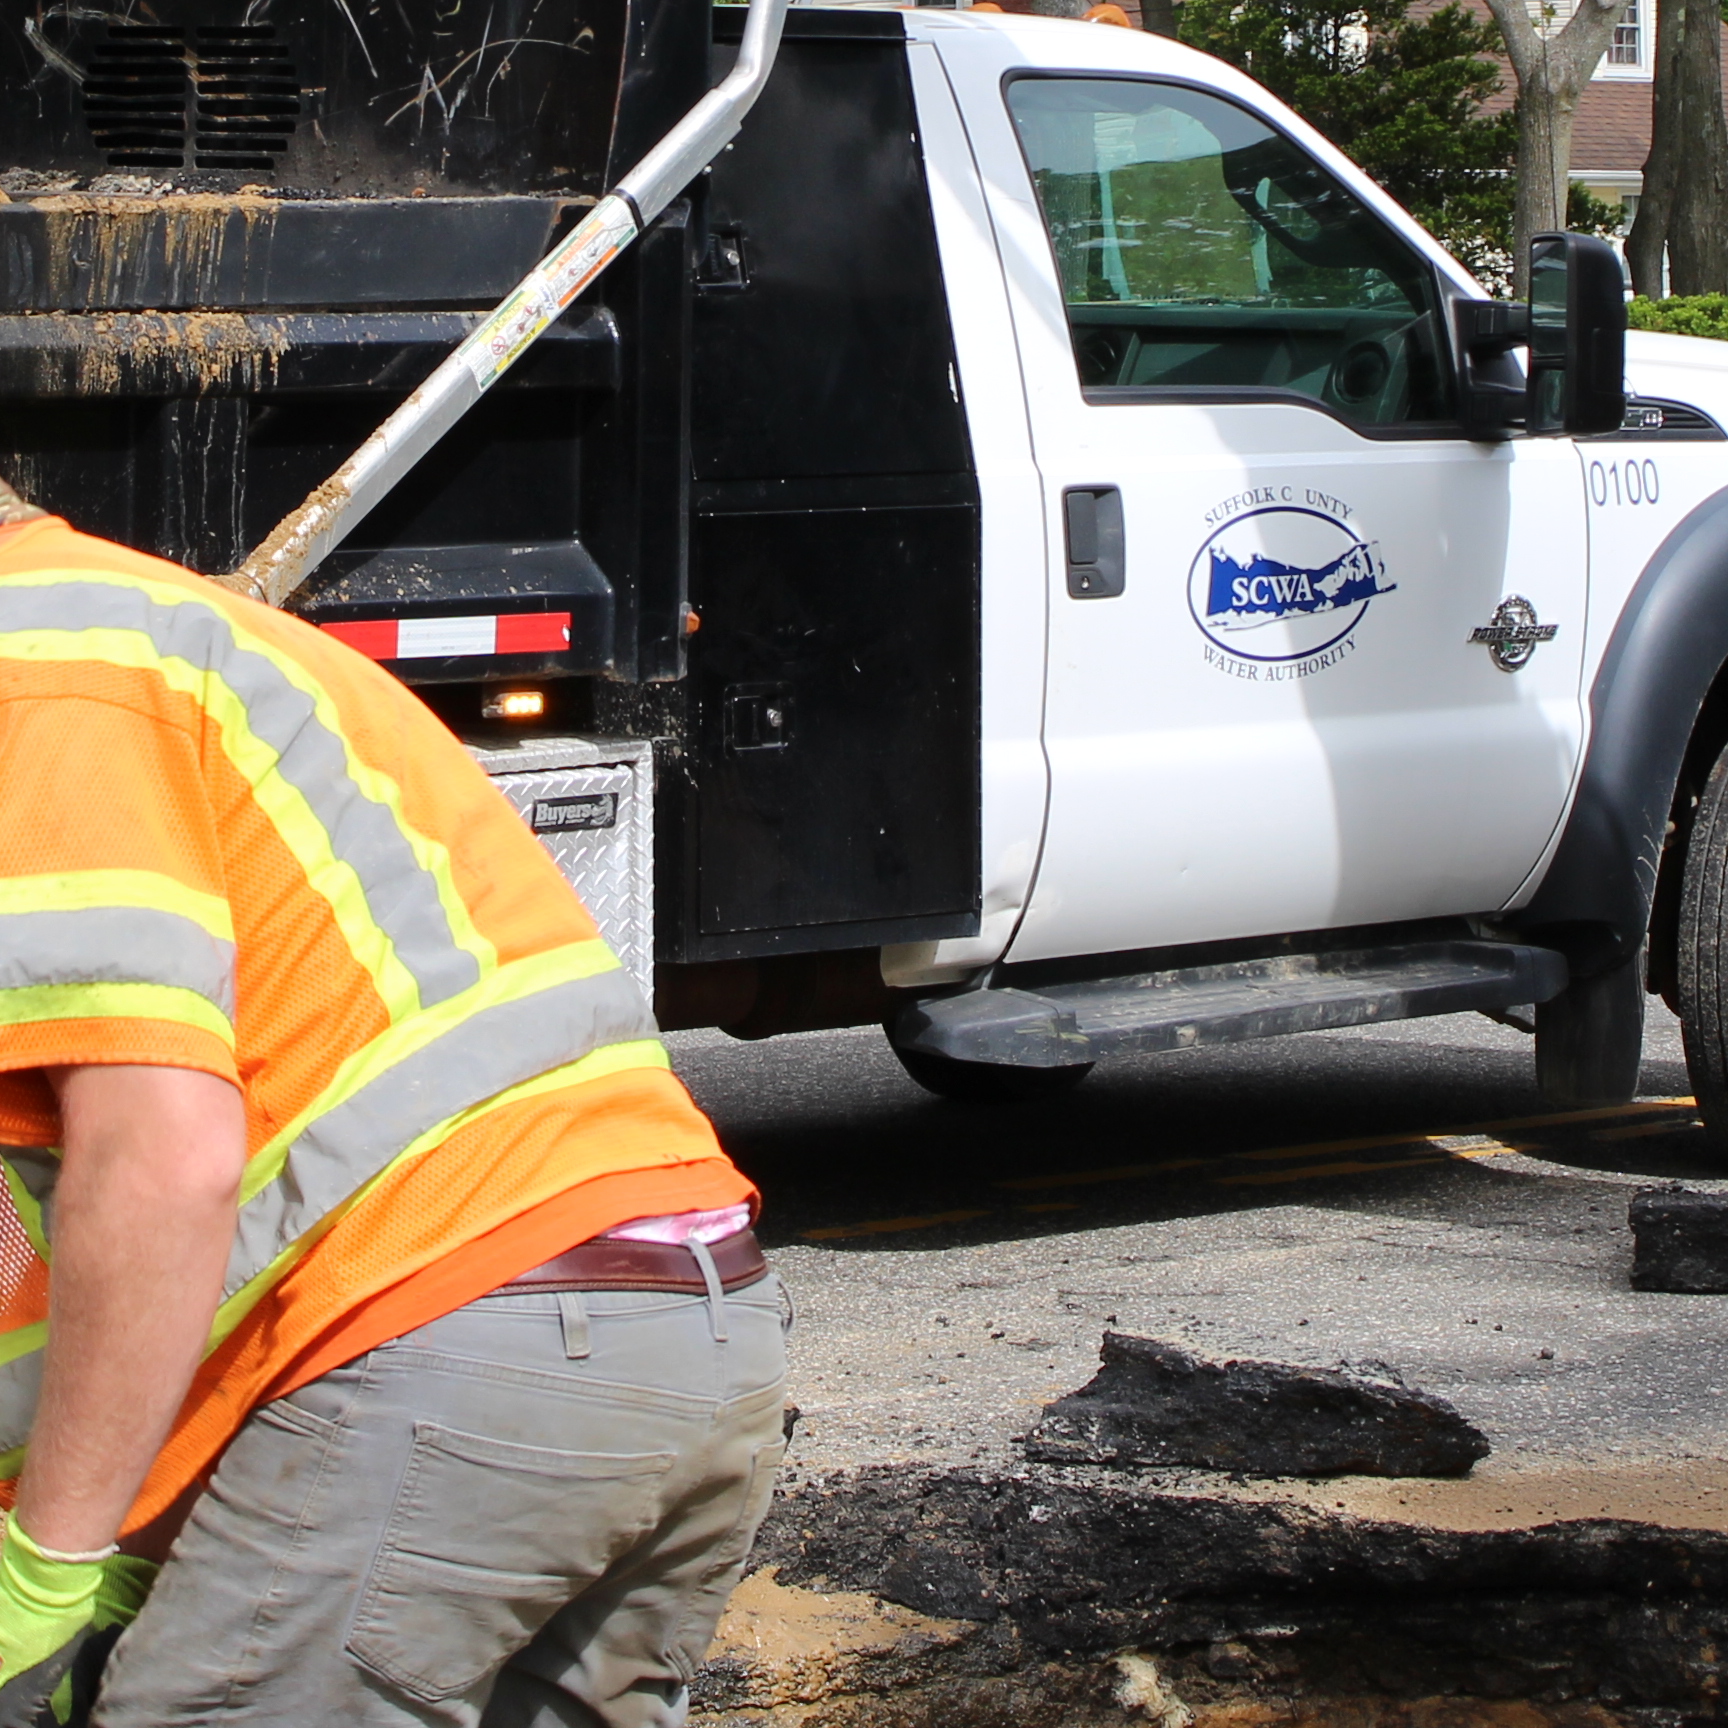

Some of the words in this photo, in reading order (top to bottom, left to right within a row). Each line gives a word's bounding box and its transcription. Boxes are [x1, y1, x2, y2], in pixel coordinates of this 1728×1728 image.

[1590, 458, 1659, 507] 0100
[1204, 486, 1276, 528] SUFFOLK
[1232, 573, 1314, 606] SCWA
[1203, 643, 1259, 681] WATER
[1264, 634, 1356, 681] AUTHORITY
[535, 803, 592, 824] Buyers
